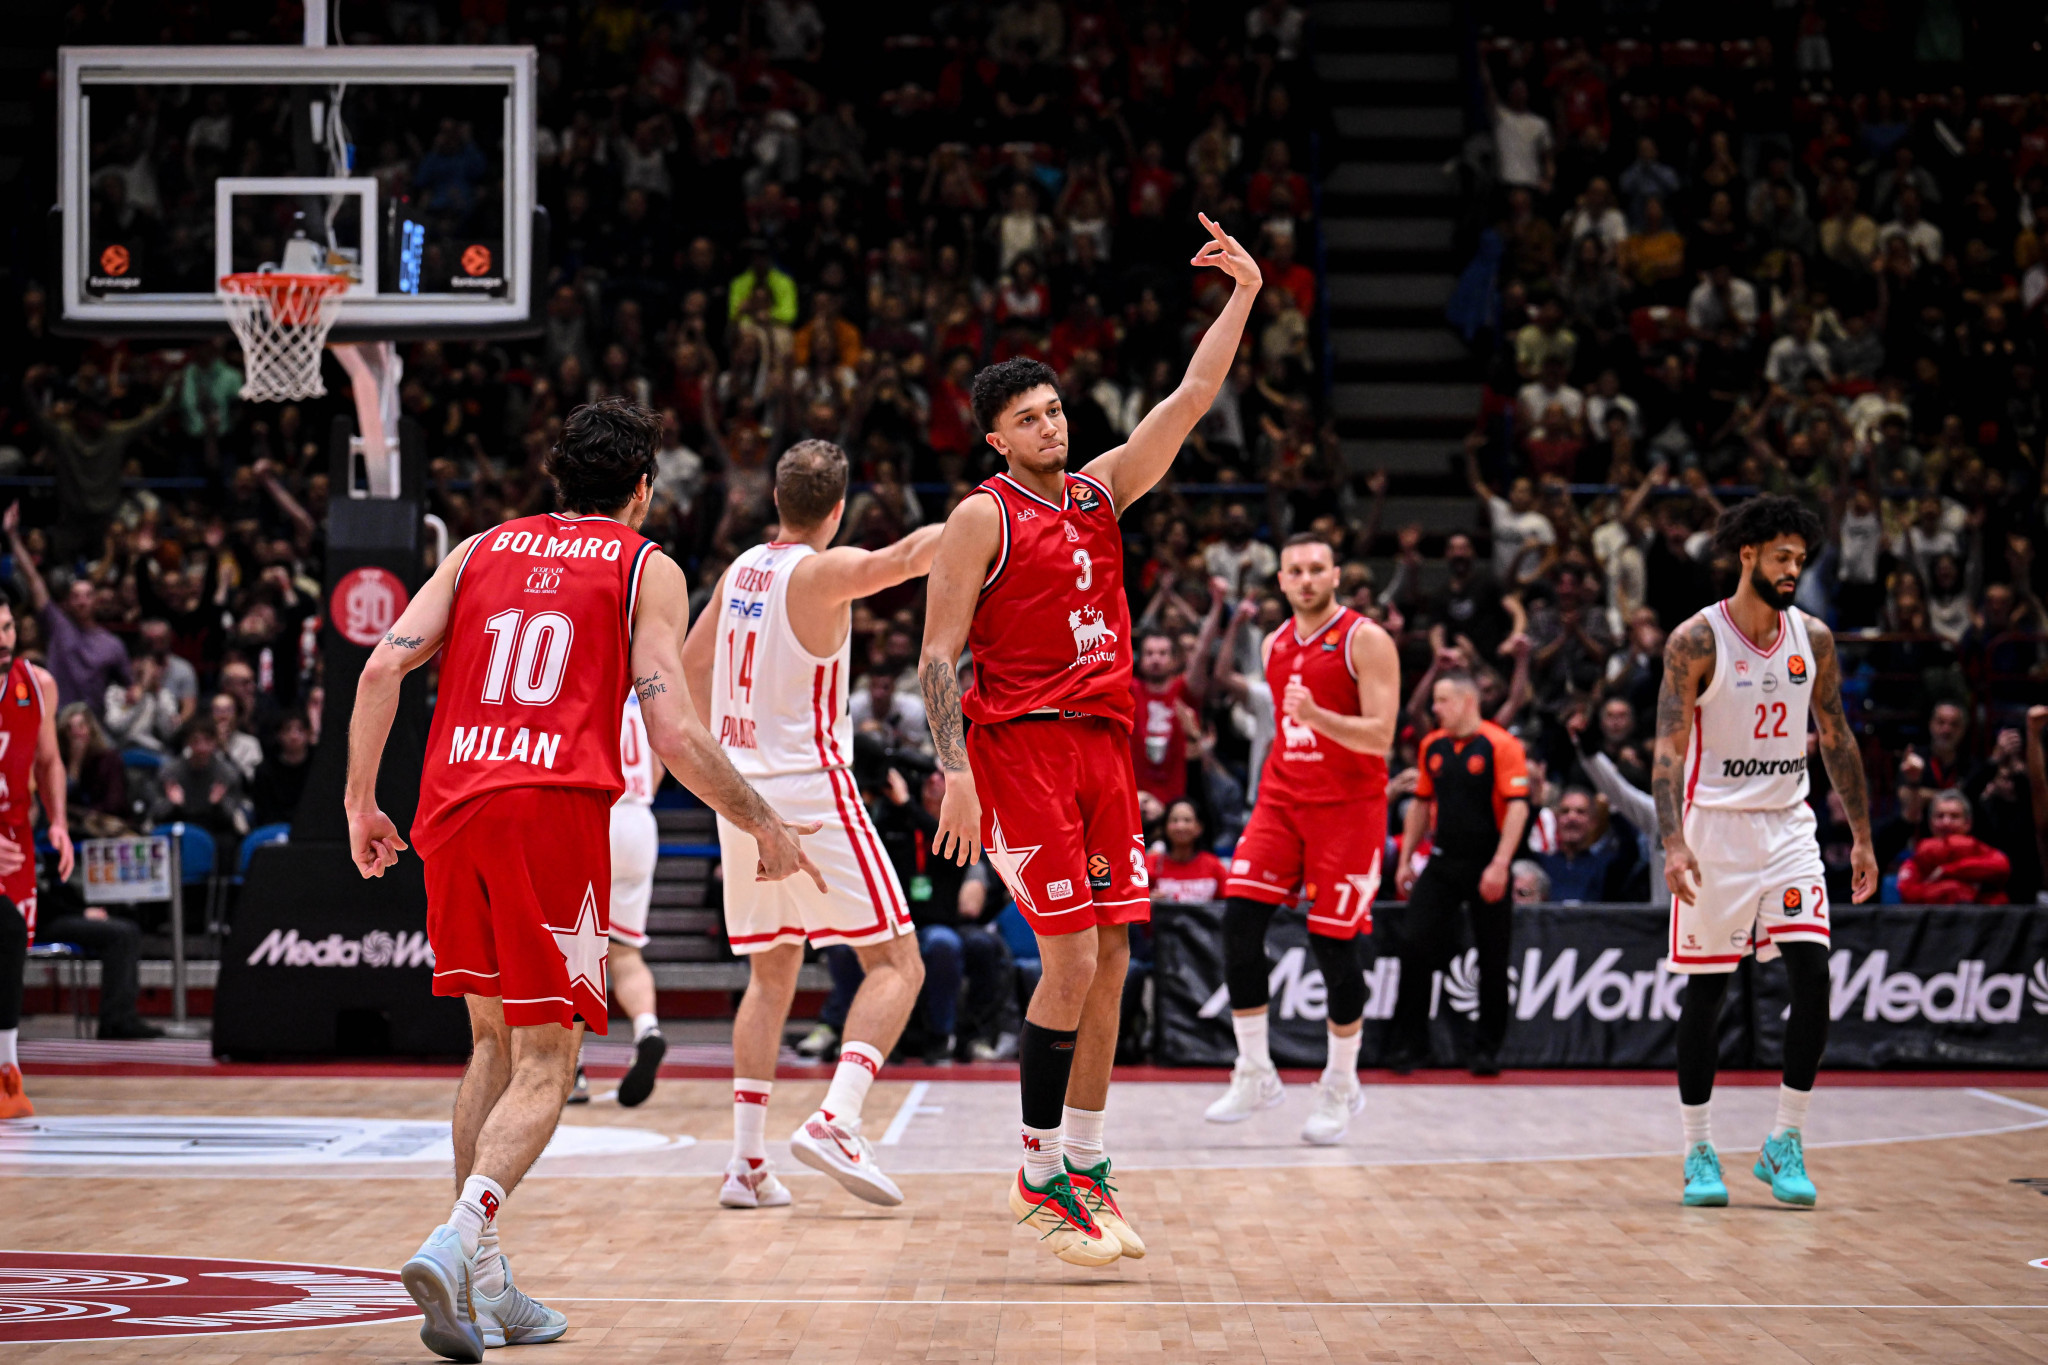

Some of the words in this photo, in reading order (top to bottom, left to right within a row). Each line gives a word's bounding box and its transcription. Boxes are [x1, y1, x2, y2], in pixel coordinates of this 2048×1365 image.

[490, 531, 622, 562] BOLMARO
[1072, 548, 1093, 592] 3
[346, 582, 395, 630] 90
[481, 608, 574, 706] 10
[728, 628, 756, 704] 14
[1754, 701, 1789, 739] 22
[448, 726, 561, 770] MILAN
[1048, 881, 1069, 892] EA7
[1129, 847, 1149, 888] 3
[1334, 882, 1352, 915] 7
[247, 929, 360, 967] Media
[1197, 947, 1442, 1020] Medi
[1780, 949, 2026, 1023] Media
